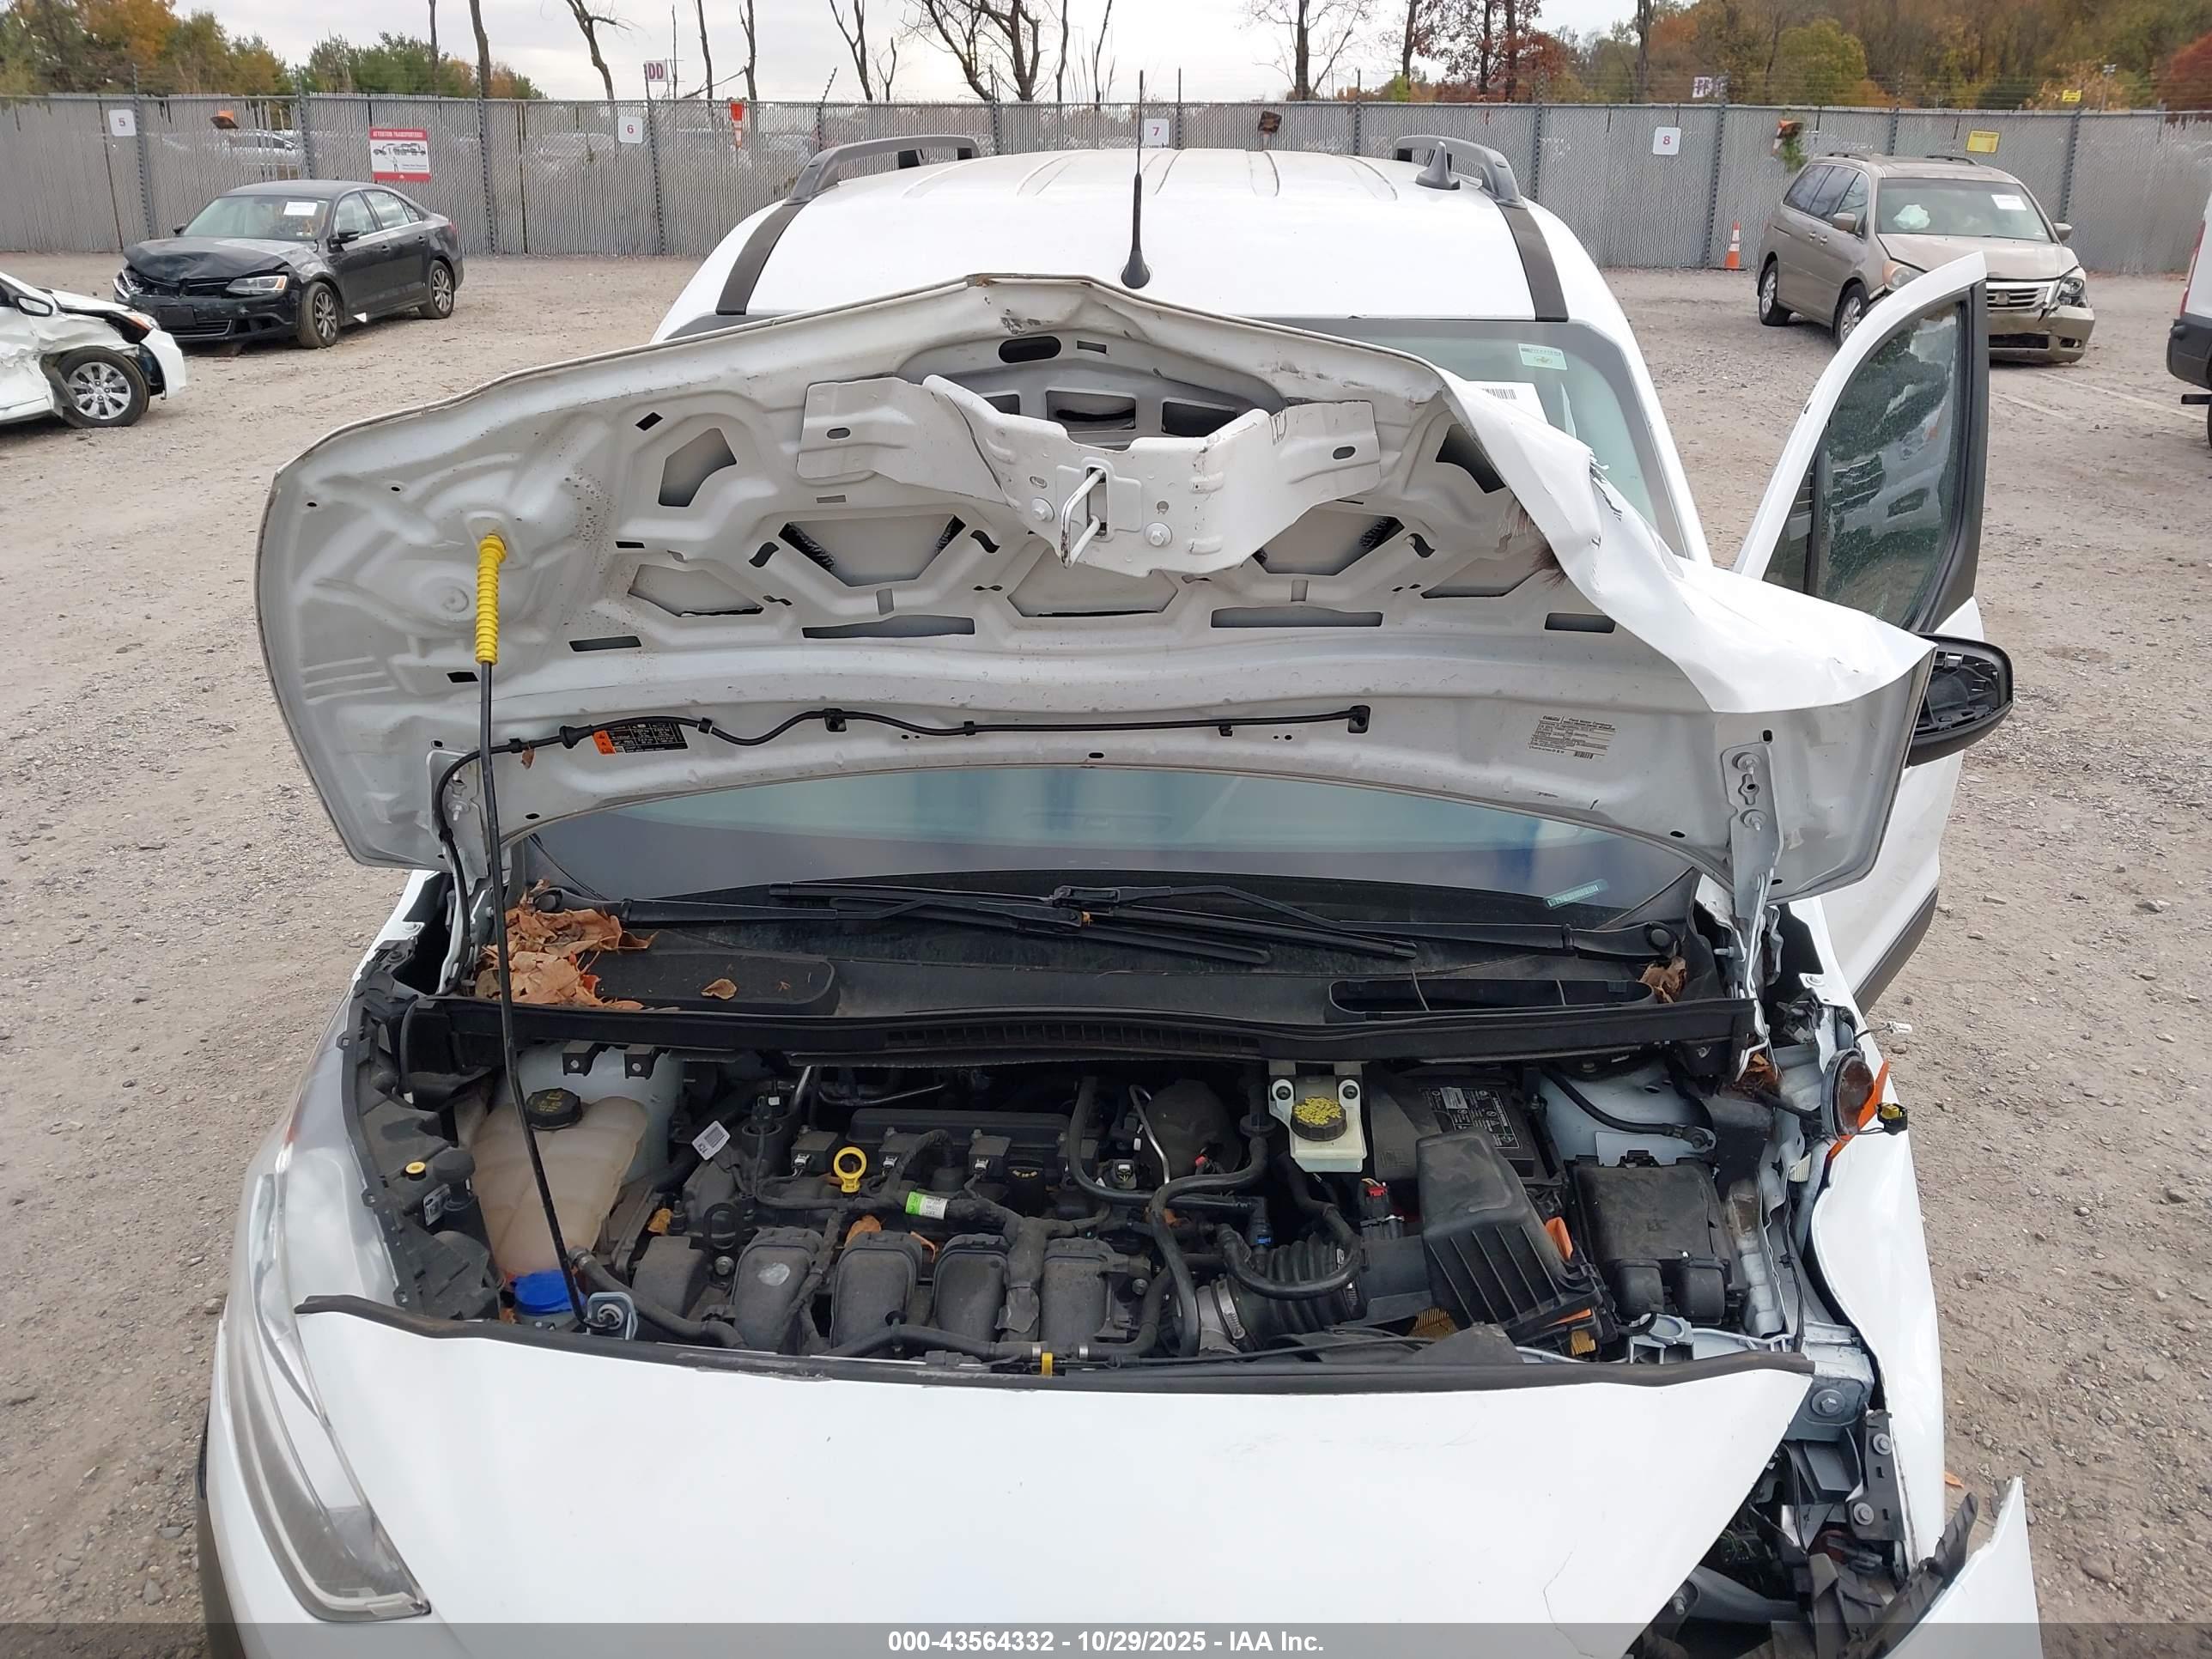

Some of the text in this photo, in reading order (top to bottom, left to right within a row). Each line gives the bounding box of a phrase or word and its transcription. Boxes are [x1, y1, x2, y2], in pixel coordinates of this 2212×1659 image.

[647, 63, 664, 80] DD
[118, 117, 125, 127] 5
[627, 124, 634, 134] 6
[1152, 126, 1160, 137] 7
[1662, 135, 1671, 145] 8
